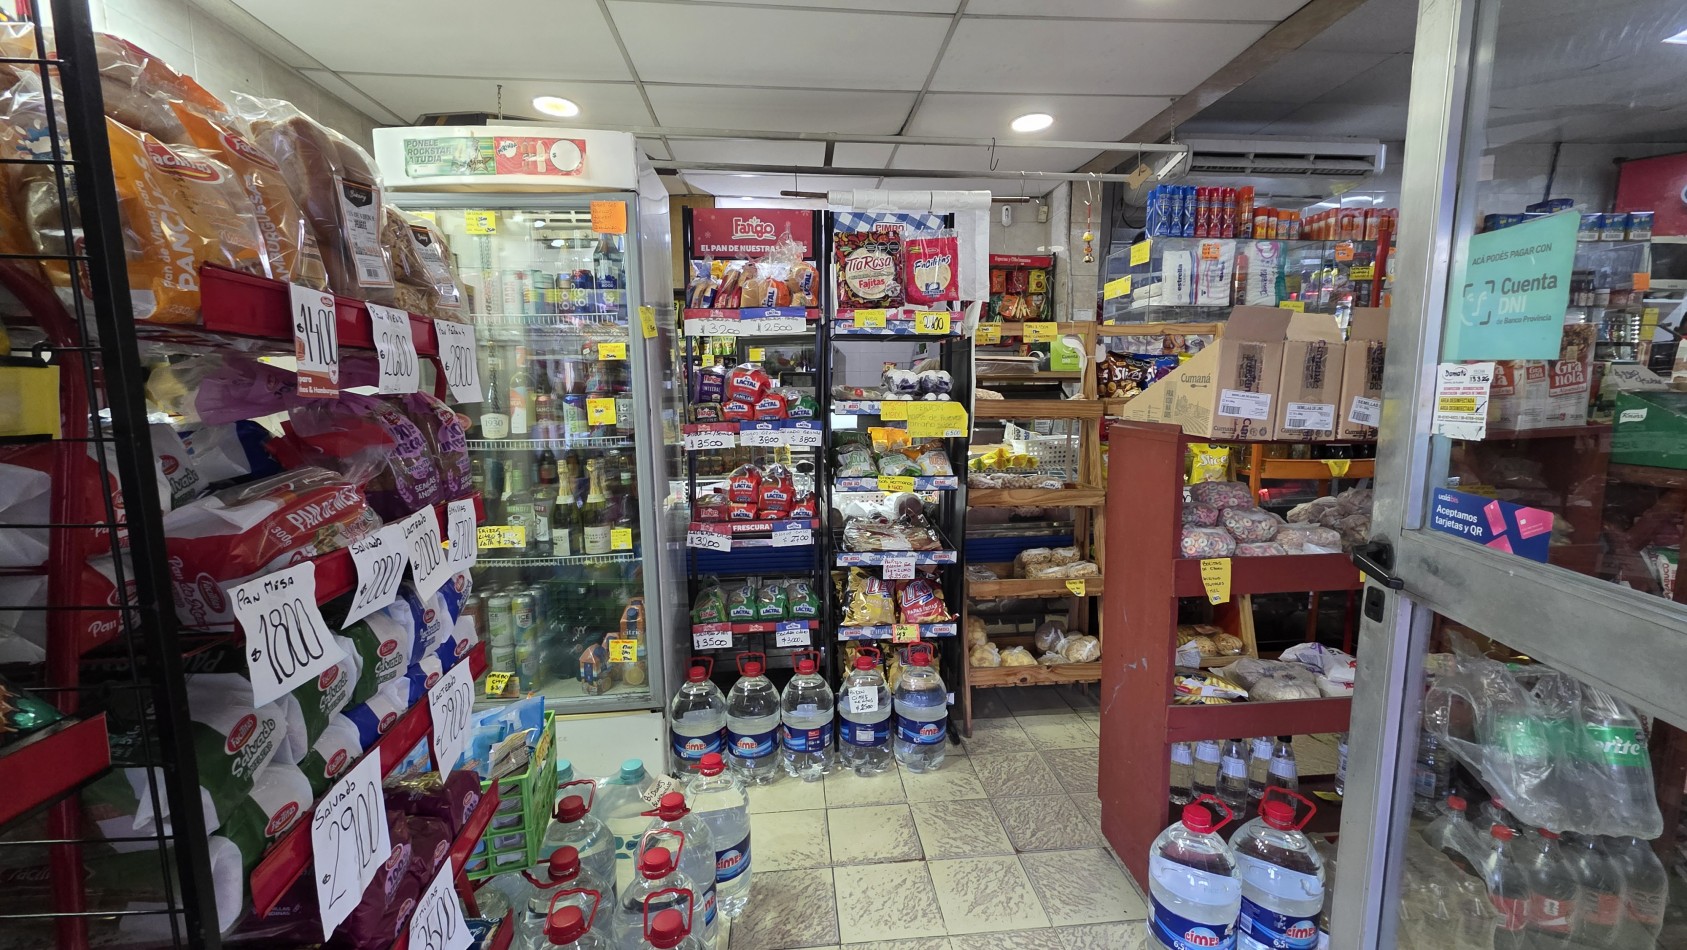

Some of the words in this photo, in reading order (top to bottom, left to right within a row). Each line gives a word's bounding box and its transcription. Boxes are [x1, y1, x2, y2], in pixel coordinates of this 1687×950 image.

[148, 212, 165, 245] Viena
[244, 175, 289, 283] AMBURGUESAS
[1472, 254, 1487, 266] ACÁ
[1486, 250, 1509, 264] PODÉS
[1510, 246, 1535, 259] PAGAR
[1535, 242, 1553, 254] CON
[858, 277, 885, 290] Fajitas
[1501, 273, 1558, 295] Cuenta
[1498, 295, 1527, 315] DNI
[1503, 316, 1523, 325] Banco
[1522, 313, 1552, 323] Provincia
[764, 323, 793, 332] 2500
[1555, 361, 1582, 374] Gra
[735, 379, 758, 389] LACTAL
[1181, 372, 1211, 384] Cumaná
[1555, 370, 1584, 386] nola
[790, 409, 811, 417] LACTAL
[697, 439, 723, 448] 3500
[759, 436, 779, 445] 3800
[171, 466, 200, 494] lvado
[734, 482, 753, 490] LACTAL
[286, 503, 323, 532] PAN
[792, 510, 812, 518] LACTAL
[1436, 504, 1478, 523] Aceptamos
[1435, 516, 1463, 531] tarjetas
[1463, 524, 1470, 534] y
[1470, 525, 1483, 537] QR
[270, 525, 292, 548] 300g
[732, 608, 751, 616] LACTAL
[762, 607, 781, 615] LACTAL
[795, 606, 814, 614] LACTAL
[702, 638, 728, 647] 3500
[229, 717, 255, 748] Facilitas
[231, 718, 275, 778] Salvado
[1602, 739, 1641, 756] rite
[326, 750, 347, 776] Facilitas
[268, 804, 297, 834] Facilitas
[1184, 926, 1219, 947] cimes
